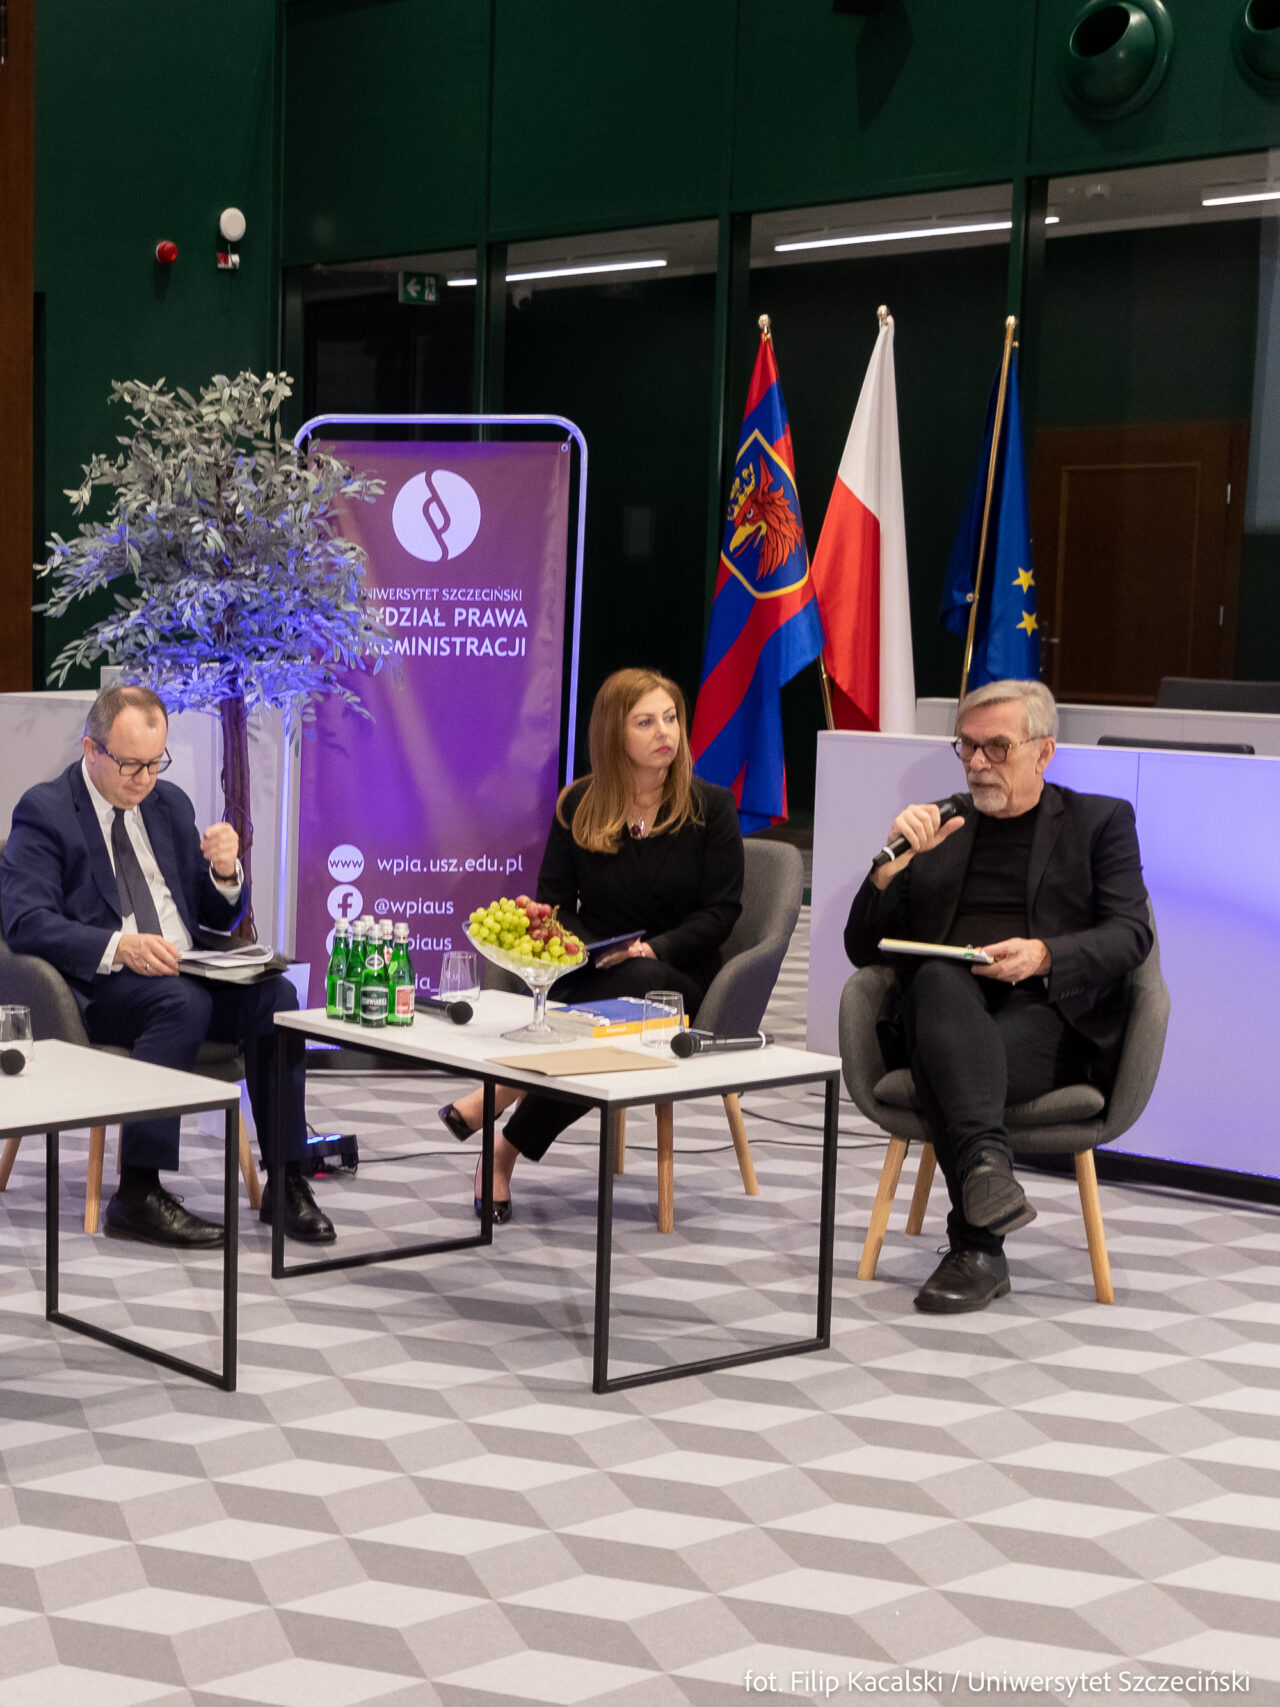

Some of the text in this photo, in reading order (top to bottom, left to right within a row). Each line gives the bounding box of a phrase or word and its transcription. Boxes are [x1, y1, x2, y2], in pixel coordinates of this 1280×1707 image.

[441, 585, 523, 602] SZCZECIŃSKI
[454, 607, 528, 628] PRAWA
[329, 854, 524, 876] www wpia.usz.edu.pl
[374, 897, 455, 918] @wpiaus
